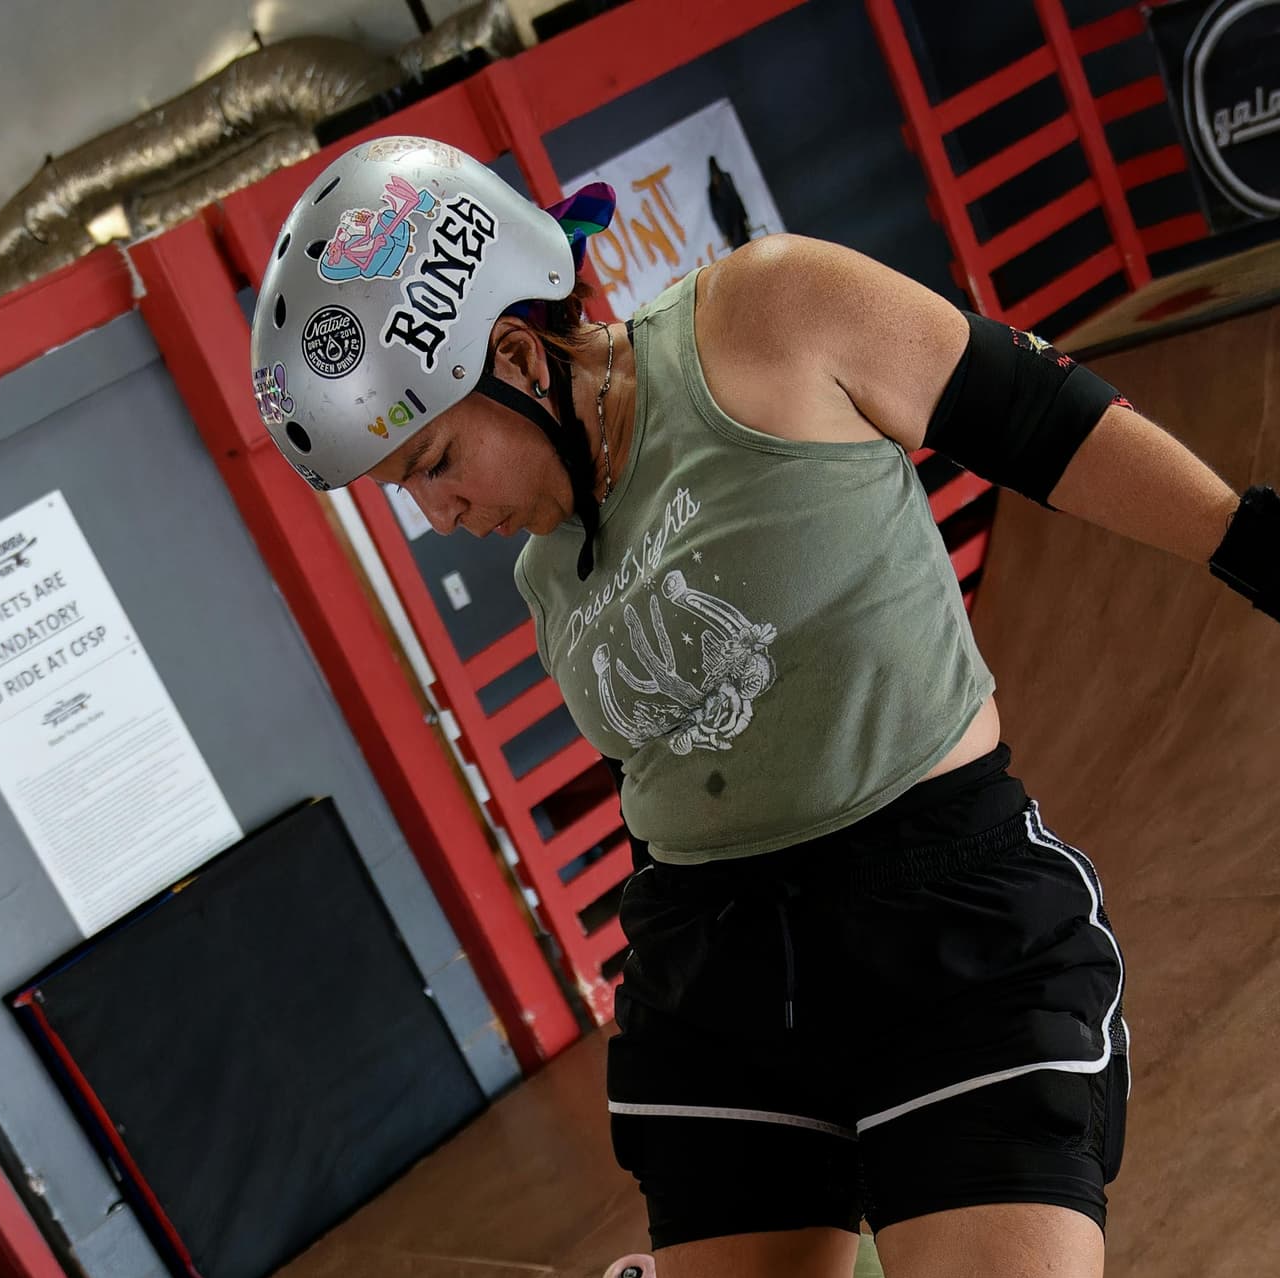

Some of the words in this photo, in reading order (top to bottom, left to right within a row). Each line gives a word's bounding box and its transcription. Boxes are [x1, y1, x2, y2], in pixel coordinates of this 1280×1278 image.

[384, 197, 496, 369] BONES
[304, 313, 351, 340] Native
[309, 351, 335, 373] SCREEN
[336, 351, 357, 372] PRINT
[34, 571, 67, 600] ARE
[566, 545, 633, 656] Desert
[620, 487, 701, 602] Nights
[4, 664, 46, 696] RIDE
[47, 648, 69, 672] AT
[70, 625, 107, 657] CFSP
